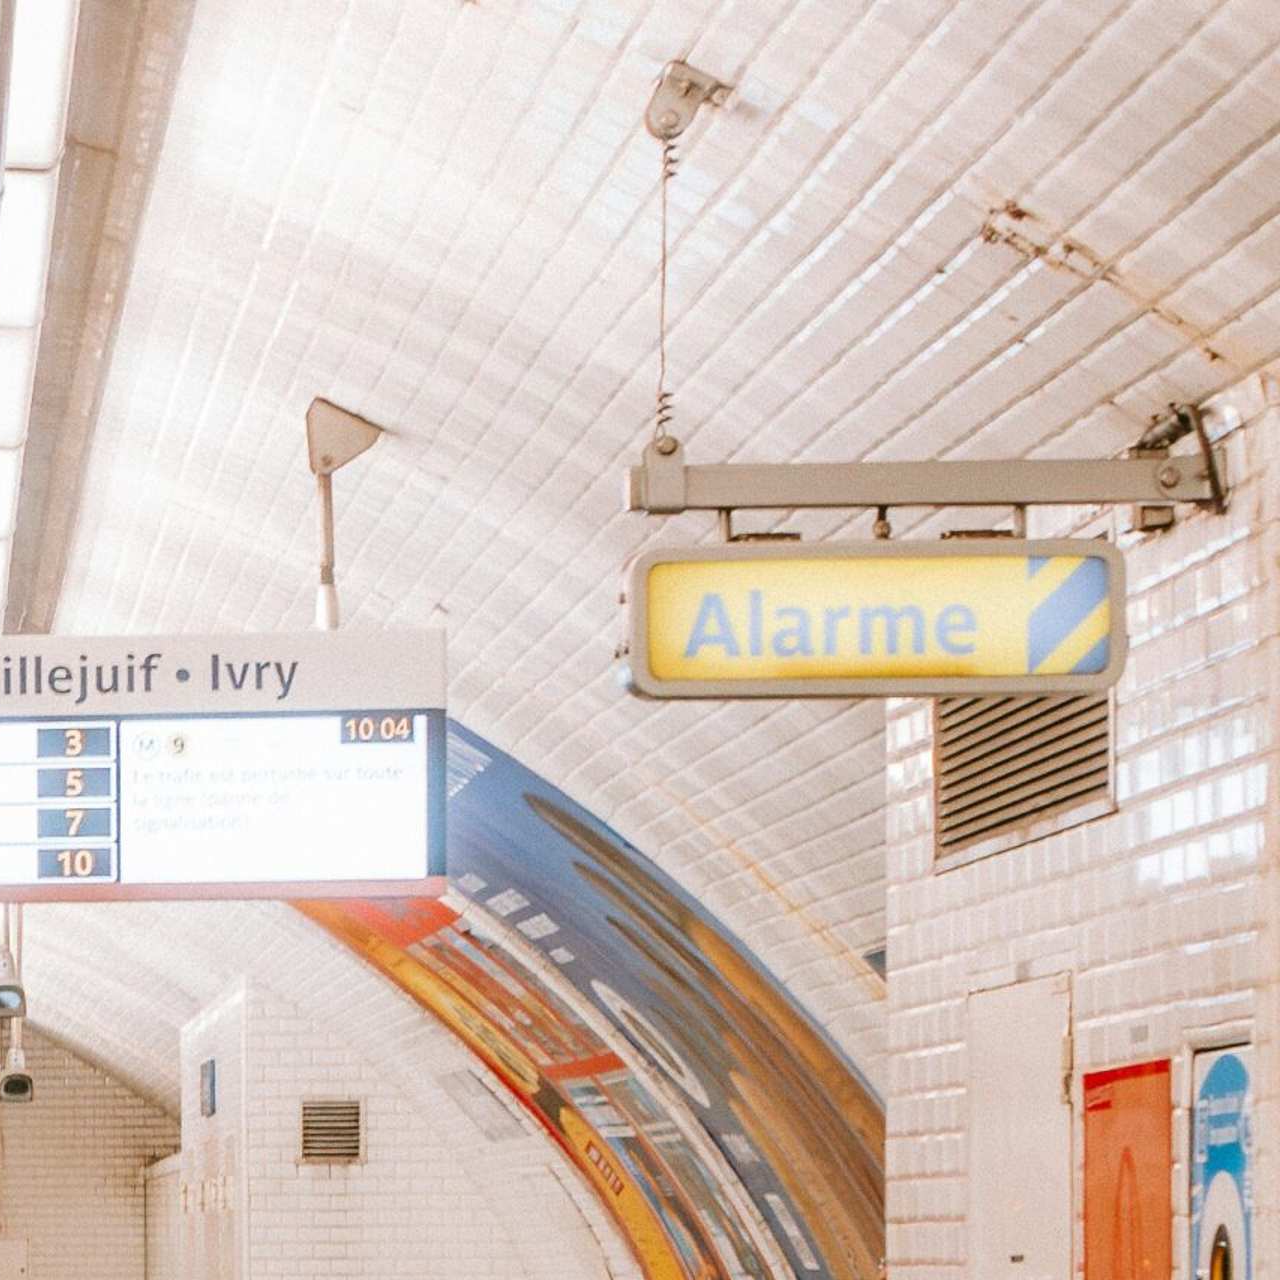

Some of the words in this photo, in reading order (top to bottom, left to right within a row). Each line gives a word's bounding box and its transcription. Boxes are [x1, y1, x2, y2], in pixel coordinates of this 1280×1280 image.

[683, 589, 978, 658] Alarme
[210, 653, 299, 700] Ivry
[64, 729, 84, 757] 3
[64, 769, 84, 797] 5
[64, 809, 85, 837] 7
[56, 849, 94, 877] 10
